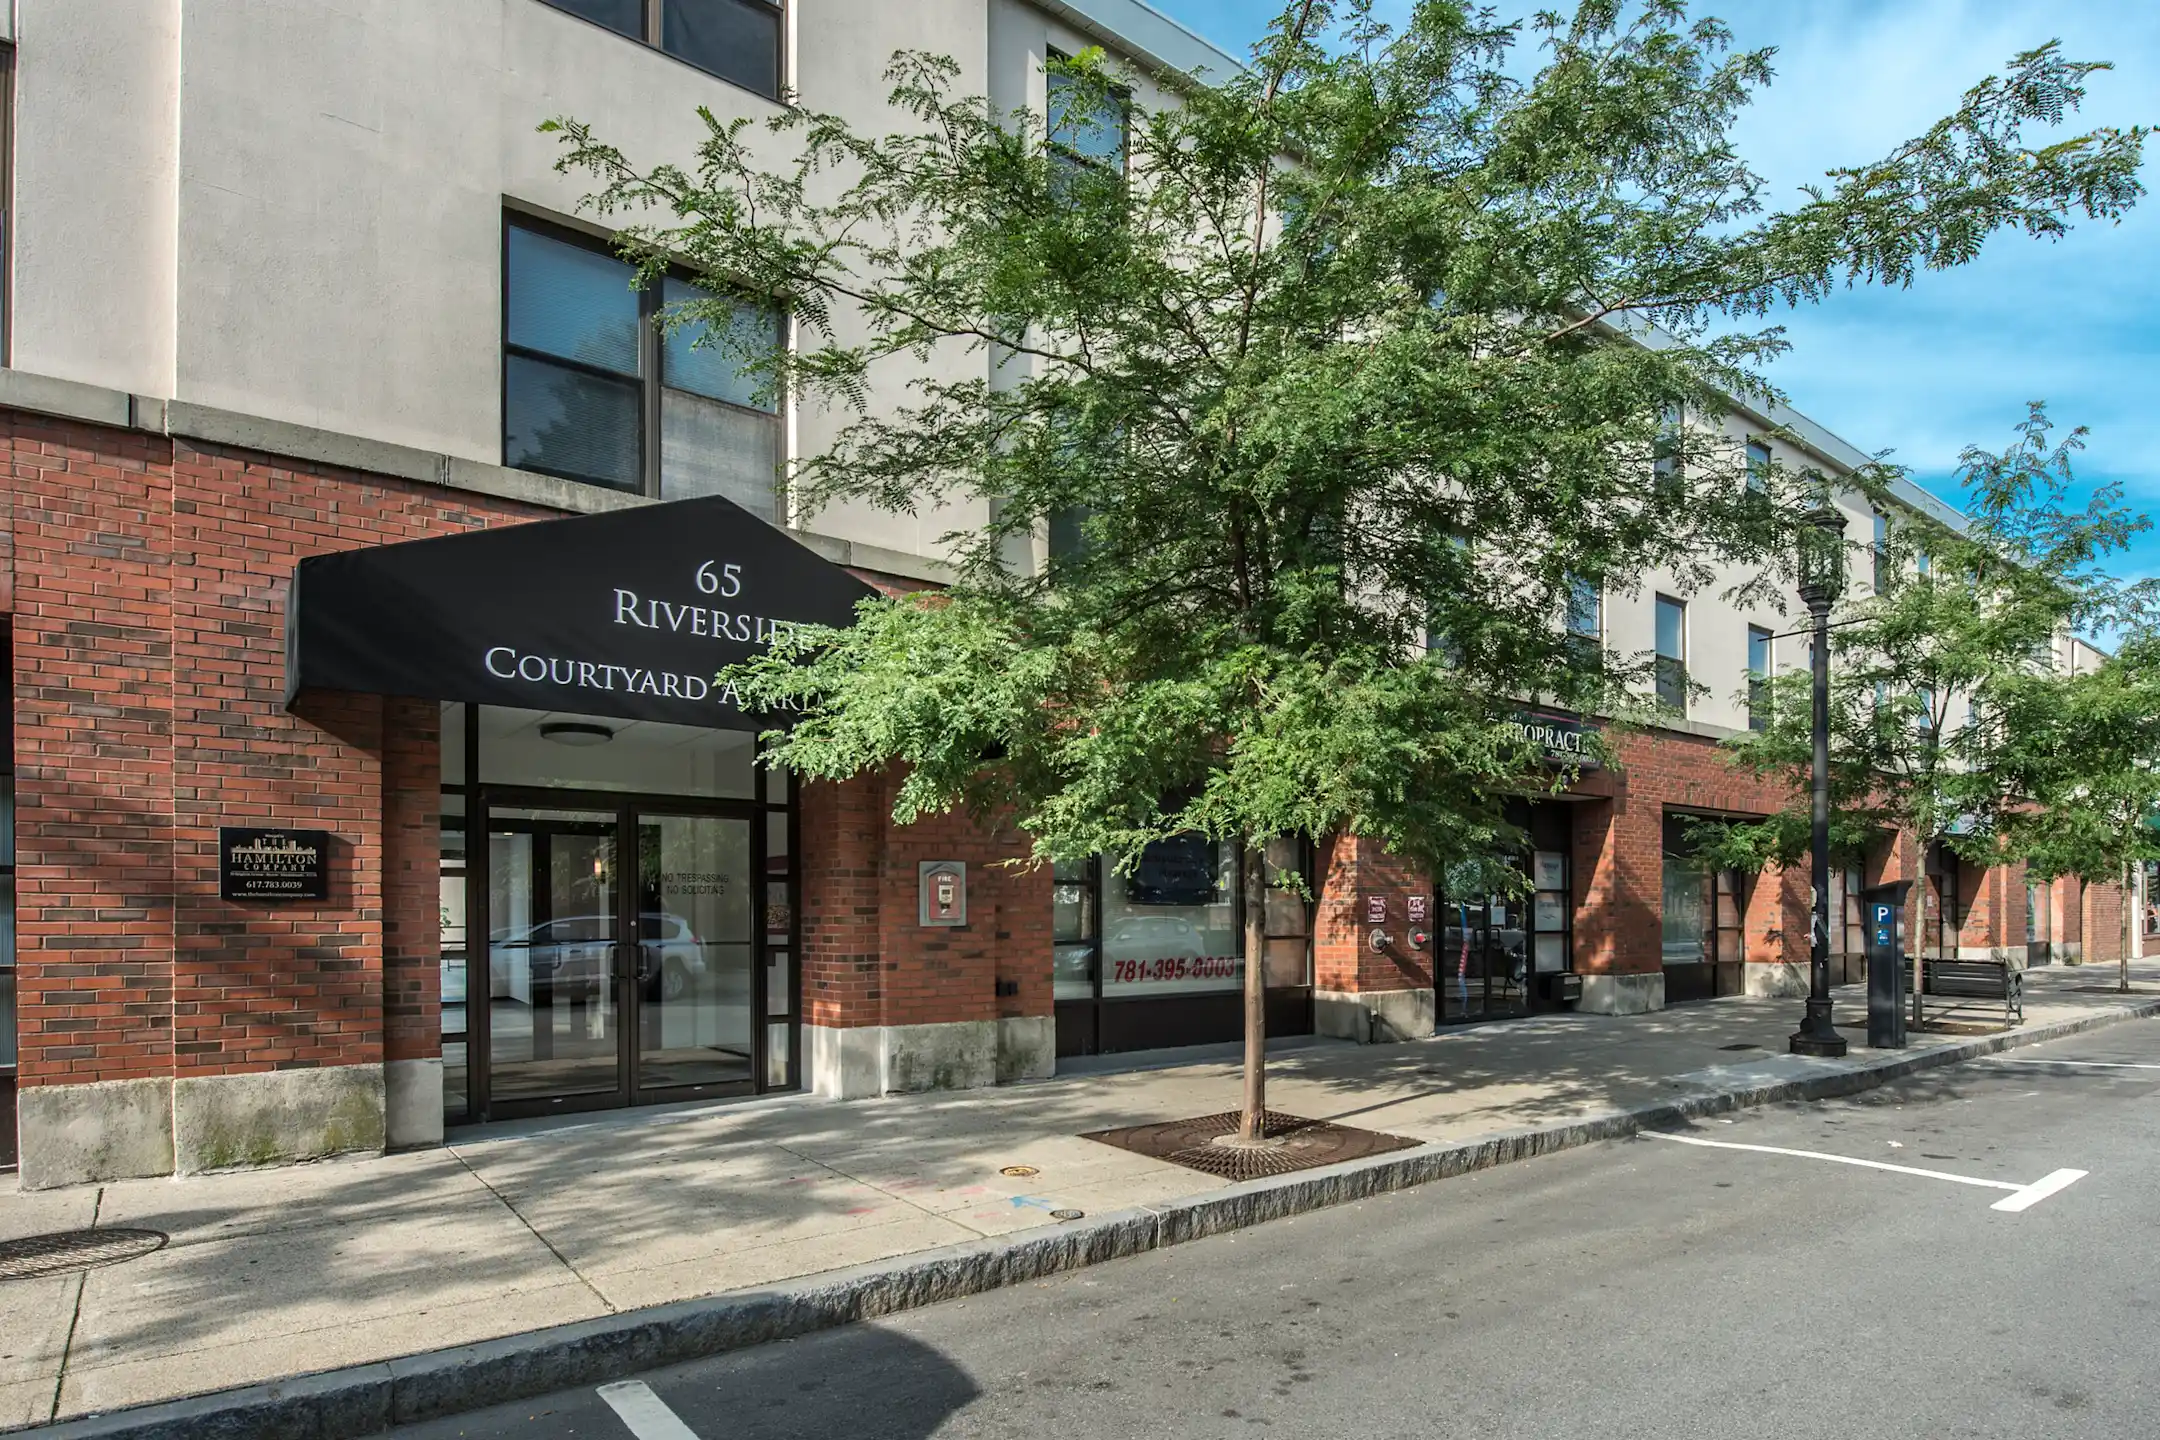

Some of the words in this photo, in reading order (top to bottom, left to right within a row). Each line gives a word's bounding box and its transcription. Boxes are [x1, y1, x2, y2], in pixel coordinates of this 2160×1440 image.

[696, 560, 742, 597] 65
[613, 588, 815, 654] RIVERSID
[485, 647, 708, 700] COURTYARD
[231, 853, 316, 864] HAMILTON
[662, 873, 674, 883] NO
[676, 873, 729, 883] TRESPASSING
[245, 881, 303, 889] 617.783.0039
[666, 885, 679, 895] NO
[682, 885, 725, 895] SOLICITING
[1877, 906, 1889, 922] P
